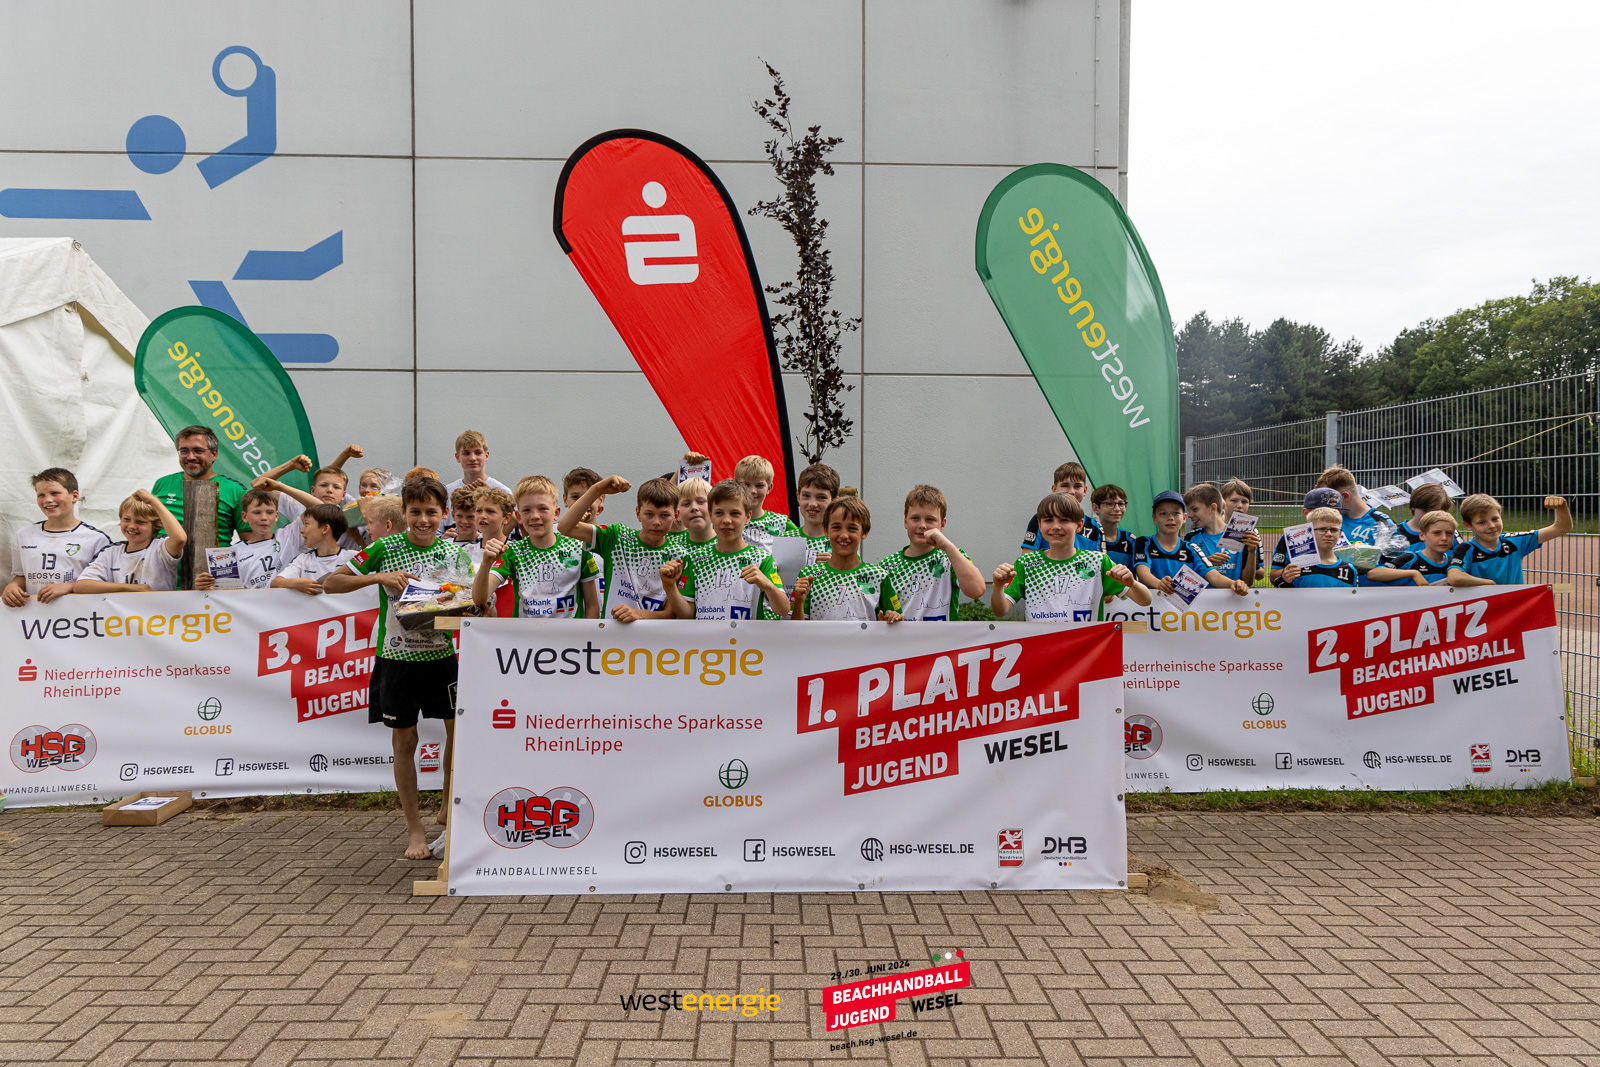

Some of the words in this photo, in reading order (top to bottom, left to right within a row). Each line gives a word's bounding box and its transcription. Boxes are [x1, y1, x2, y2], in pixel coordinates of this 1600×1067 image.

[1082, 527, 1093, 538] 17
[1351, 525, 1371, 542] 44
[1121, 541, 1129, 552] 7
[559, 550, 571, 558] HSV
[1179, 550, 1188, 562] 5
[42, 553, 57, 570] 13
[259, 555, 276, 572] 12
[637, 557, 650, 578] 8
[1074, 562, 1088, 570] HSV
[28, 572, 61, 580] BEOSYS
[250, 572, 274, 586] BEOS
[537, 562, 555, 582] 13
[715, 567, 733, 588] 14
[856, 575, 871, 583] HSV
[1338, 567, 1350, 581] 11
[1053, 574, 1070, 594] 17
[836, 585, 848, 605] 7
[1031, 611, 1068, 619] Volksbank
[21, 604, 232, 643] westenergie
[1316, 629, 1350, 668] 2.
[1364, 600, 1489, 659] PLATZ
[266, 631, 302, 670] 3.
[496, 637, 764, 686] westenergie
[1123, 660, 1216, 673] ederrheinische
[1219, 659, 1283, 674] Sparkasse
[1353, 638, 1515, 686] BEACHHANDBALL
[44, 665, 163, 682] Niederrheinische
[165, 662, 231, 680] Sparkasse
[43, 683, 122, 699] RheinLippe
[807, 677, 838, 727] 1.
[857, 642, 1023, 718] PLATZ
[1123, 678, 1181, 691] einLippe
[1352, 685, 1427, 716] JUGEND
[1453, 667, 1519, 695] WESEL
[525, 713, 673, 731] Niederrheinische
[677, 713, 763, 734] Sparkasse
[855, 690, 1069, 750] BEACHHANDBALL
[1242, 719, 1287, 730] GLOBUS
[184, 724, 233, 737] GLOBUS
[21, 731, 86, 760] HSG
[525, 736, 623, 756] RheinLippe
[27, 753, 80, 769] WESEL
[332, 755, 394, 768] HSG-WESEL.D
[850, 751, 949, 790] JUGEND
[984, 730, 1068, 764] WESEL
[1207, 758, 1257, 767] HSGWESEL
[1296, 757, 1345, 767] HSGWESEL
[1385, 754, 1453, 766] HSG-WESEL.DE
[1505, 749, 1541, 763] DHB
[143, 765, 195, 776] HSGWESEL
[238, 761, 290, 773] HSGWESEL
[1126, 772, 1170, 780] LINWESEL
[3, 783, 98, 795] #HANDBALLINWESEL
[702, 794, 763, 808] GLOBUS
[498, 796, 580, 833] HSG
[505, 825, 572, 843] WESEL
[653, 846, 718, 858] HSGWESEL
[772, 846, 836, 858] HSGWESEL
[889, 843, 975, 855] HSG-WESEL.DE
[1041, 836, 1088, 854] DHB
[475, 866, 598, 877] #HANDBALLINWESEL
